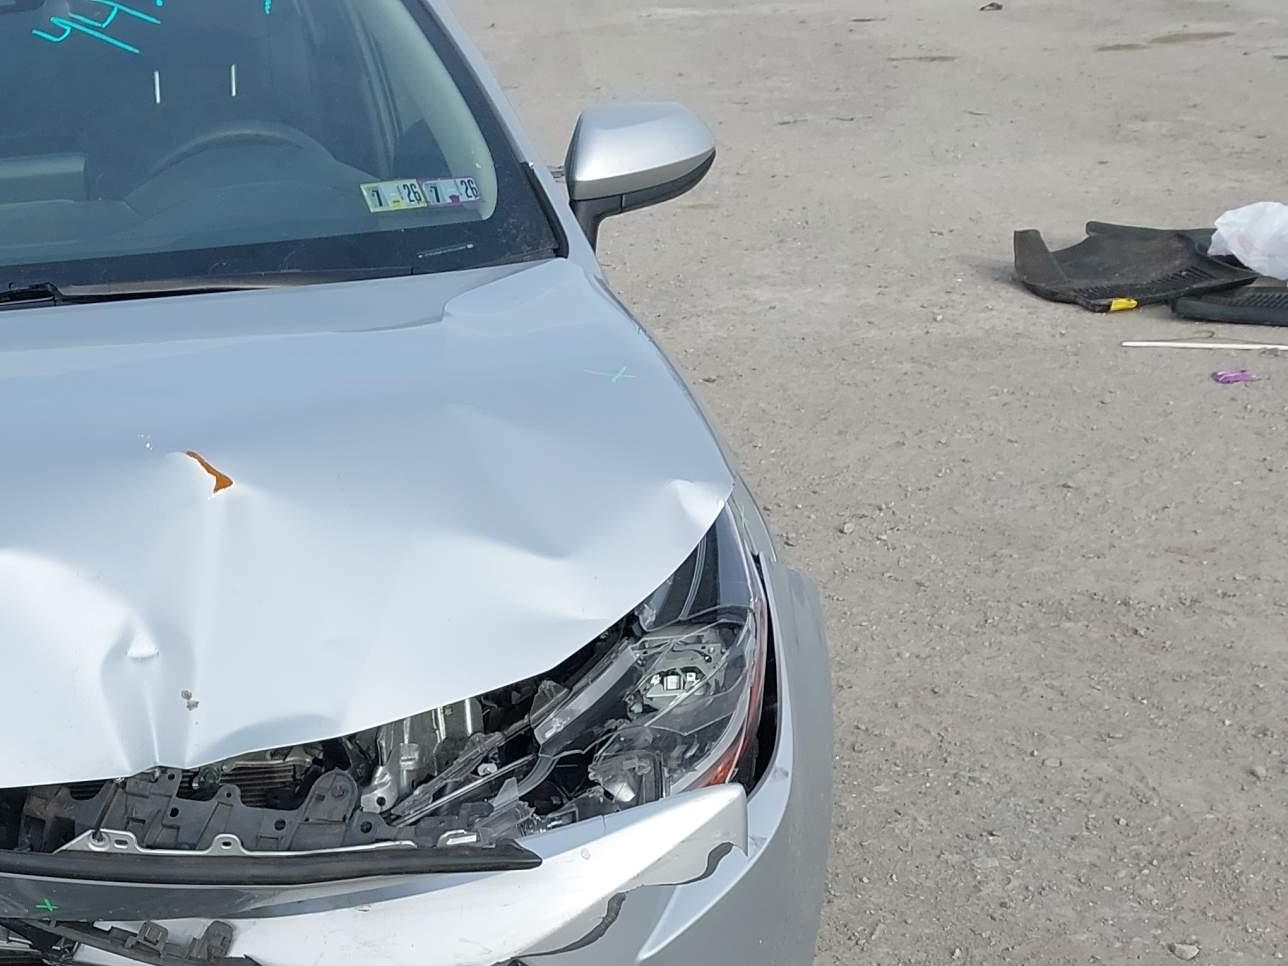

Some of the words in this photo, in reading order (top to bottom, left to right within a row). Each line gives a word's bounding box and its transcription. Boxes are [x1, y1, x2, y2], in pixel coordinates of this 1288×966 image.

[372, 189, 383, 207] 7
[403, 183, 422, 203] 26
[430, 186, 440, 203] 7
